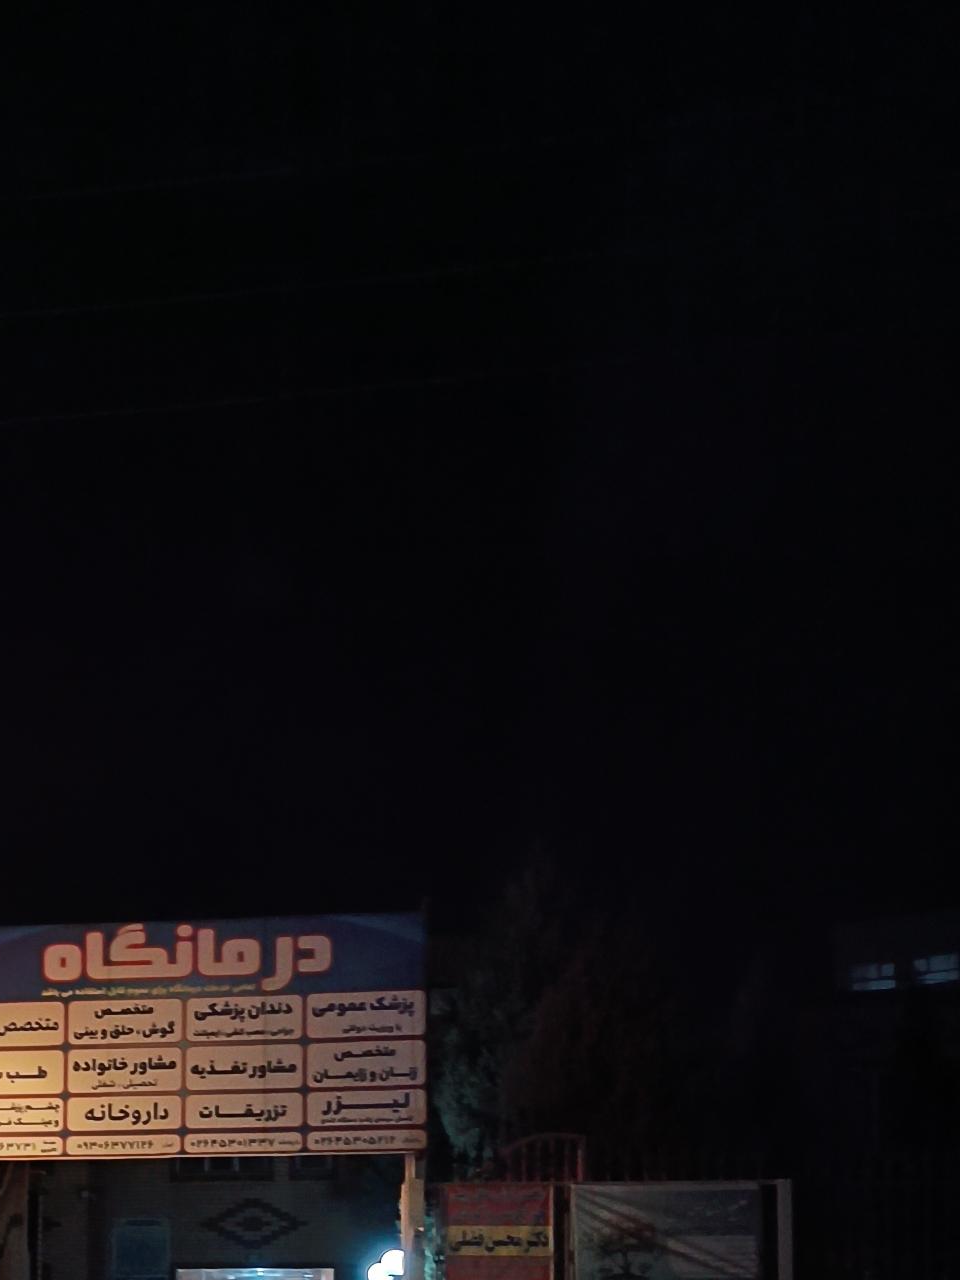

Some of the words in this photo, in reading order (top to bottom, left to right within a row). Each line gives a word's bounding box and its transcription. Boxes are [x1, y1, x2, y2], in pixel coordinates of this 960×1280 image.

[43, 923, 332, 991] درمانگاه
[95, 1004, 154, 1019] متخصص
[194, 1000, 246, 1022] پزشکی
[247, 1001, 292, 1019] دندان
[312, 1001, 367, 1017] عمومی
[370, 995, 415, 1016] پزشک
[74, 1025, 100, 1040] بینی
[334, 1044, 396, 1061] متخصص
[6, 1065, 48, 1083] طب
[73, 1056, 128, 1077] خانواده
[130, 1055, 176, 1076] مشاور
[190, 1059, 247, 1079] تغذیه
[249, 1058, 297, 1079] مشاور
[313, 1065, 368, 1083] زایمان
[379, 1065, 418, 1082] زنان
[369, 1070, 377, 1083] و
[85, 1102, 169, 1124] داروخانه
[199, 1103, 287, 1122] تزریقات
[322, 1092, 410, 1116] لیزر
